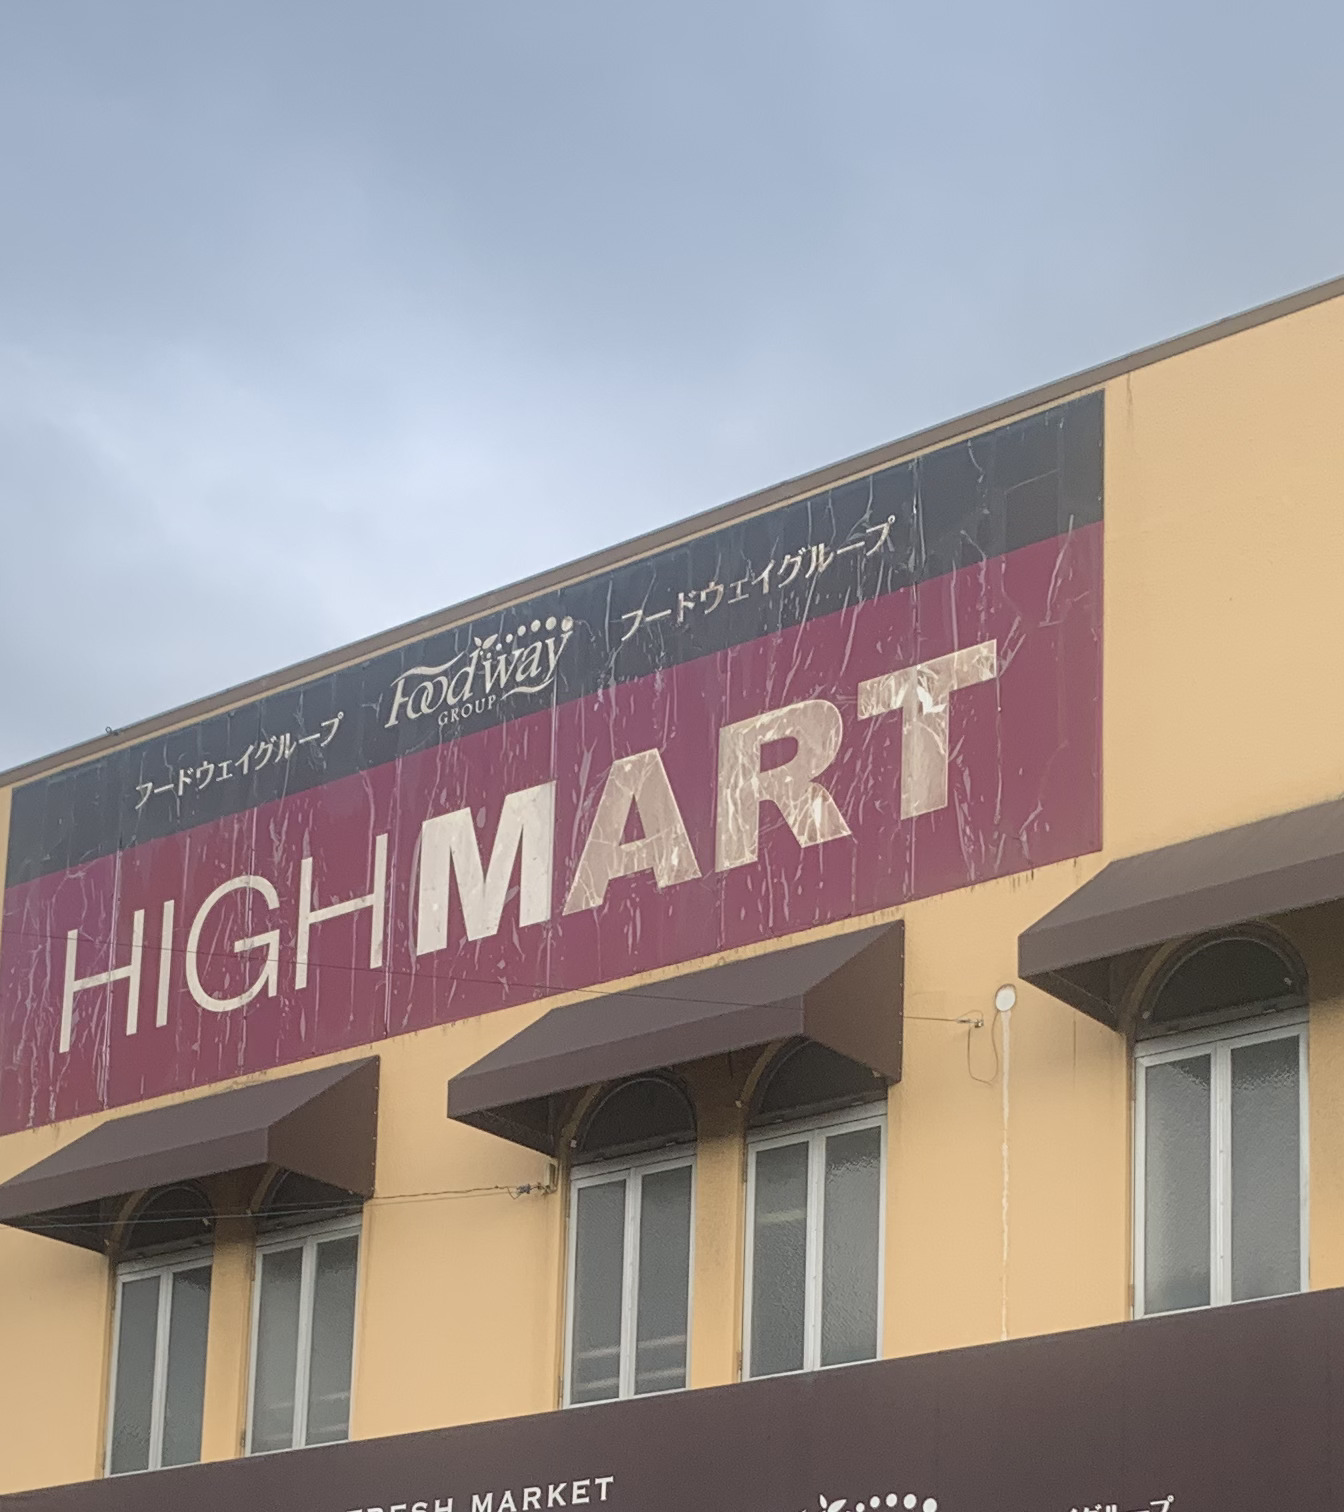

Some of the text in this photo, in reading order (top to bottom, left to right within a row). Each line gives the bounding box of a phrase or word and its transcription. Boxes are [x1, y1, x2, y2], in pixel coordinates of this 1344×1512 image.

[619, 515, 896, 642] フードウェイグループ
[383, 616, 573, 730] Foodway
[438, 695, 497, 727] GROUP
[134, 711, 344, 810] フードウェイグループ
